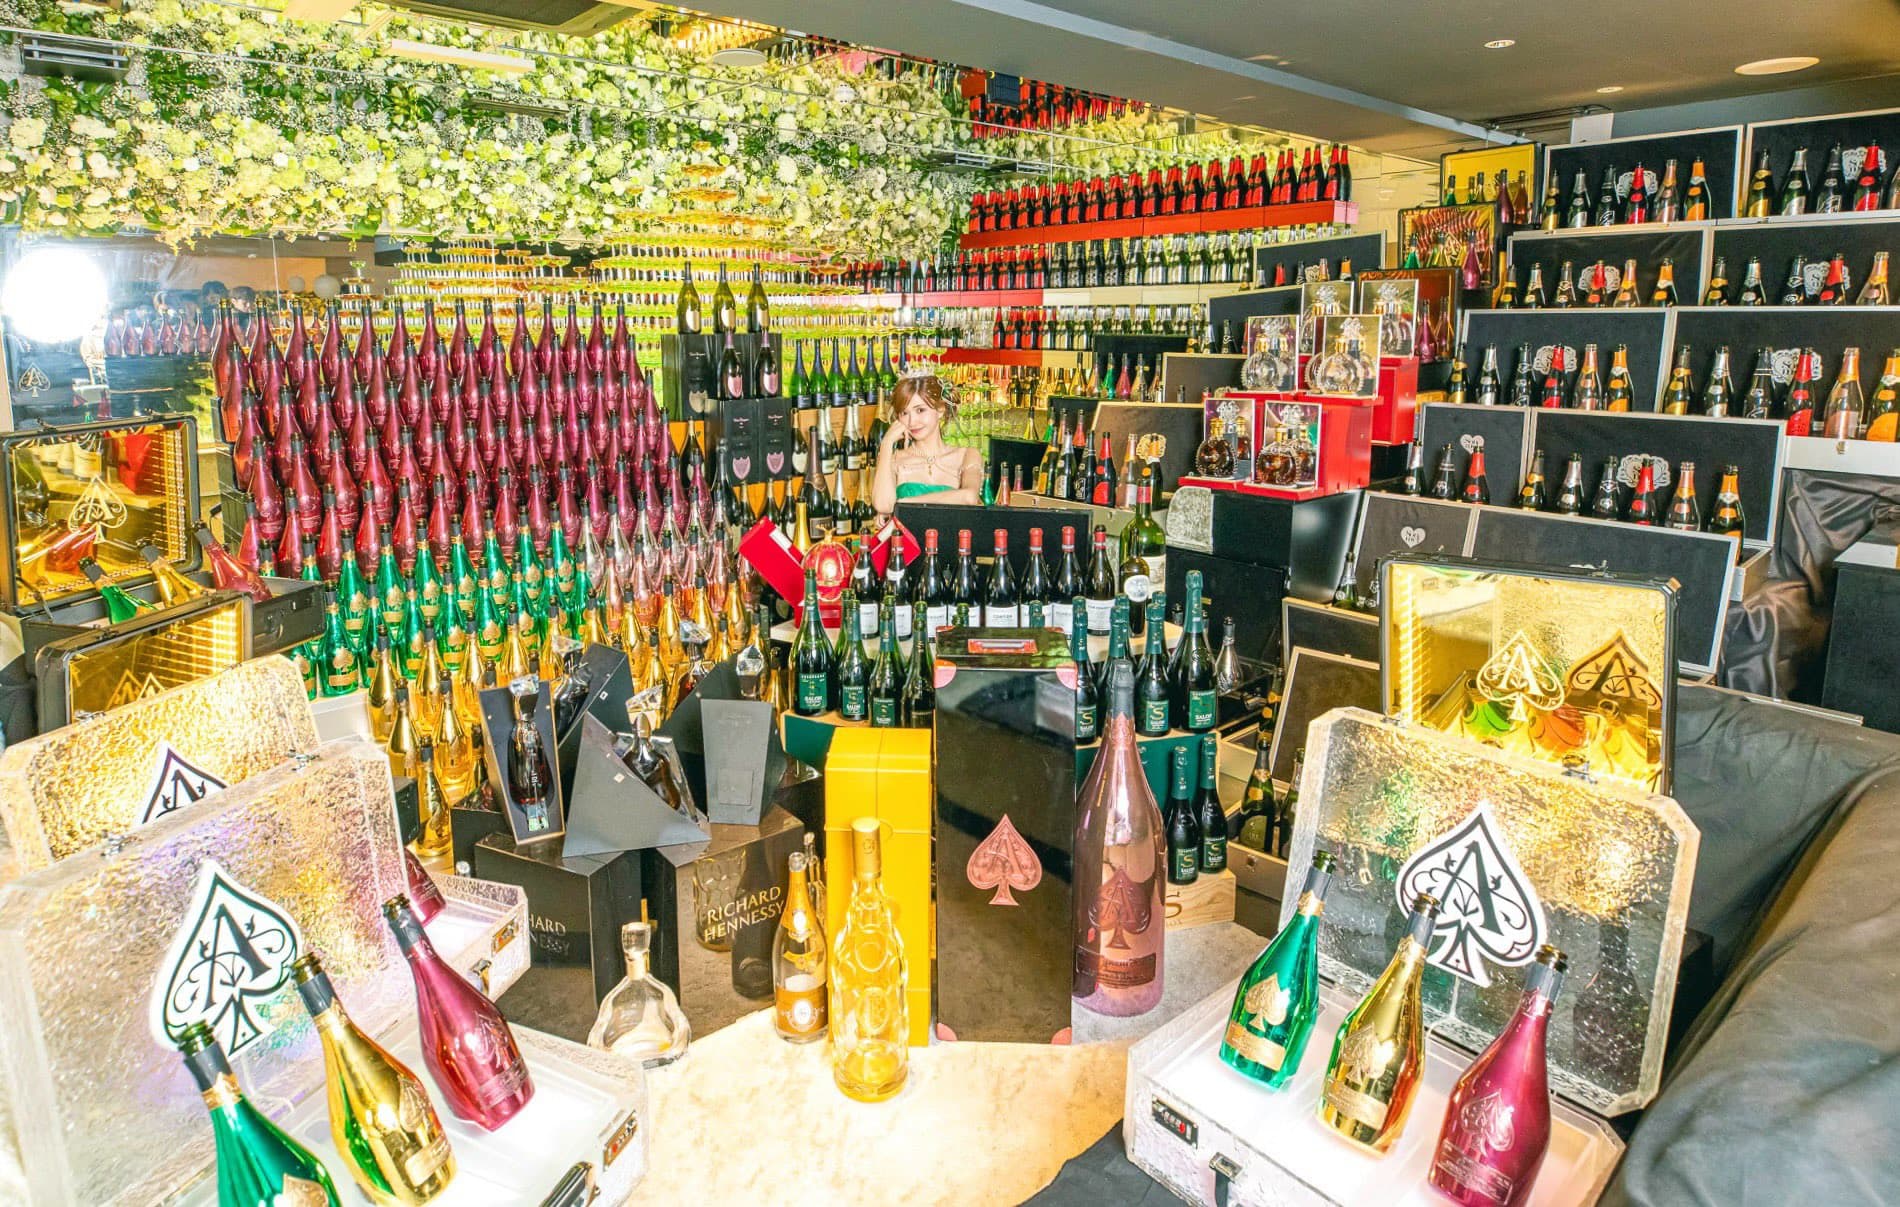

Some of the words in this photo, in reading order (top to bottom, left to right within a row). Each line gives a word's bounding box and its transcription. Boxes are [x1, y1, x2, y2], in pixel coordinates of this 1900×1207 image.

[529, 913, 566, 936] HARD
[704, 900, 784, 943] HENNESSY
[707, 886, 781, 925] RICHARD
